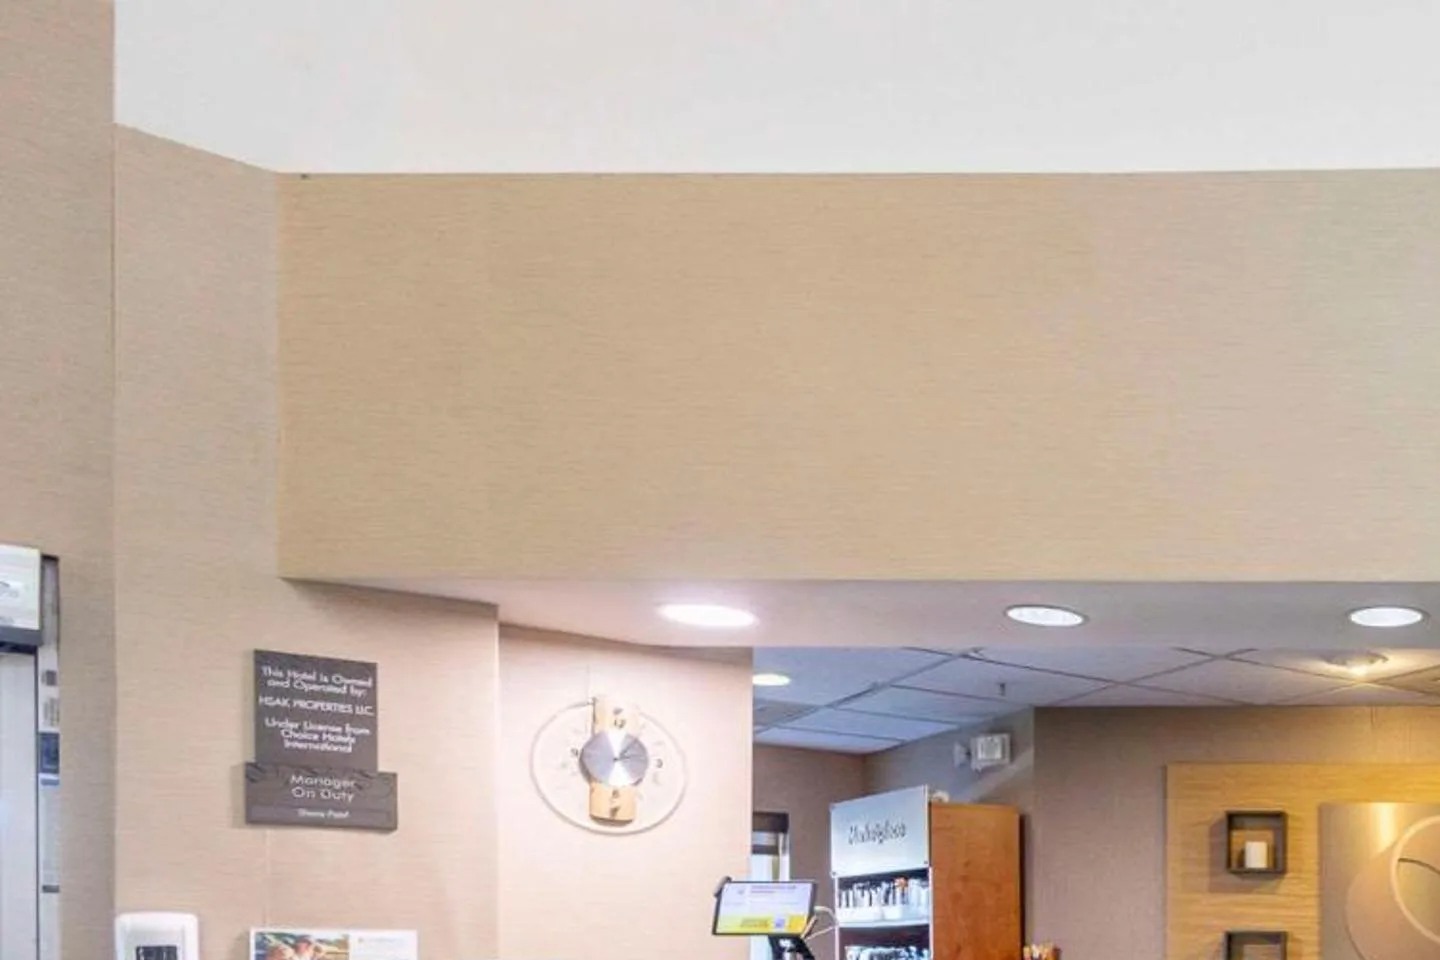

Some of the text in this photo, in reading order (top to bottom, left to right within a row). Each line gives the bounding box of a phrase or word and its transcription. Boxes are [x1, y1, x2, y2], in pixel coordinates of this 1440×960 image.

[262, 665, 283, 677] This
[287, 668, 316, 681] Hotel
[332, 675, 372, 687] Owned
[267, 678, 290, 688] and
[294, 680, 347, 694] Operated
[293, 700, 353, 714] PROPERTIES
[265, 717, 371, 735] Under License from
[280, 728, 356, 745] Choice Hotels
[284, 740, 353, 753] International
[291, 775, 356, 789] Manager
[291, 786, 355, 804] On Duty
